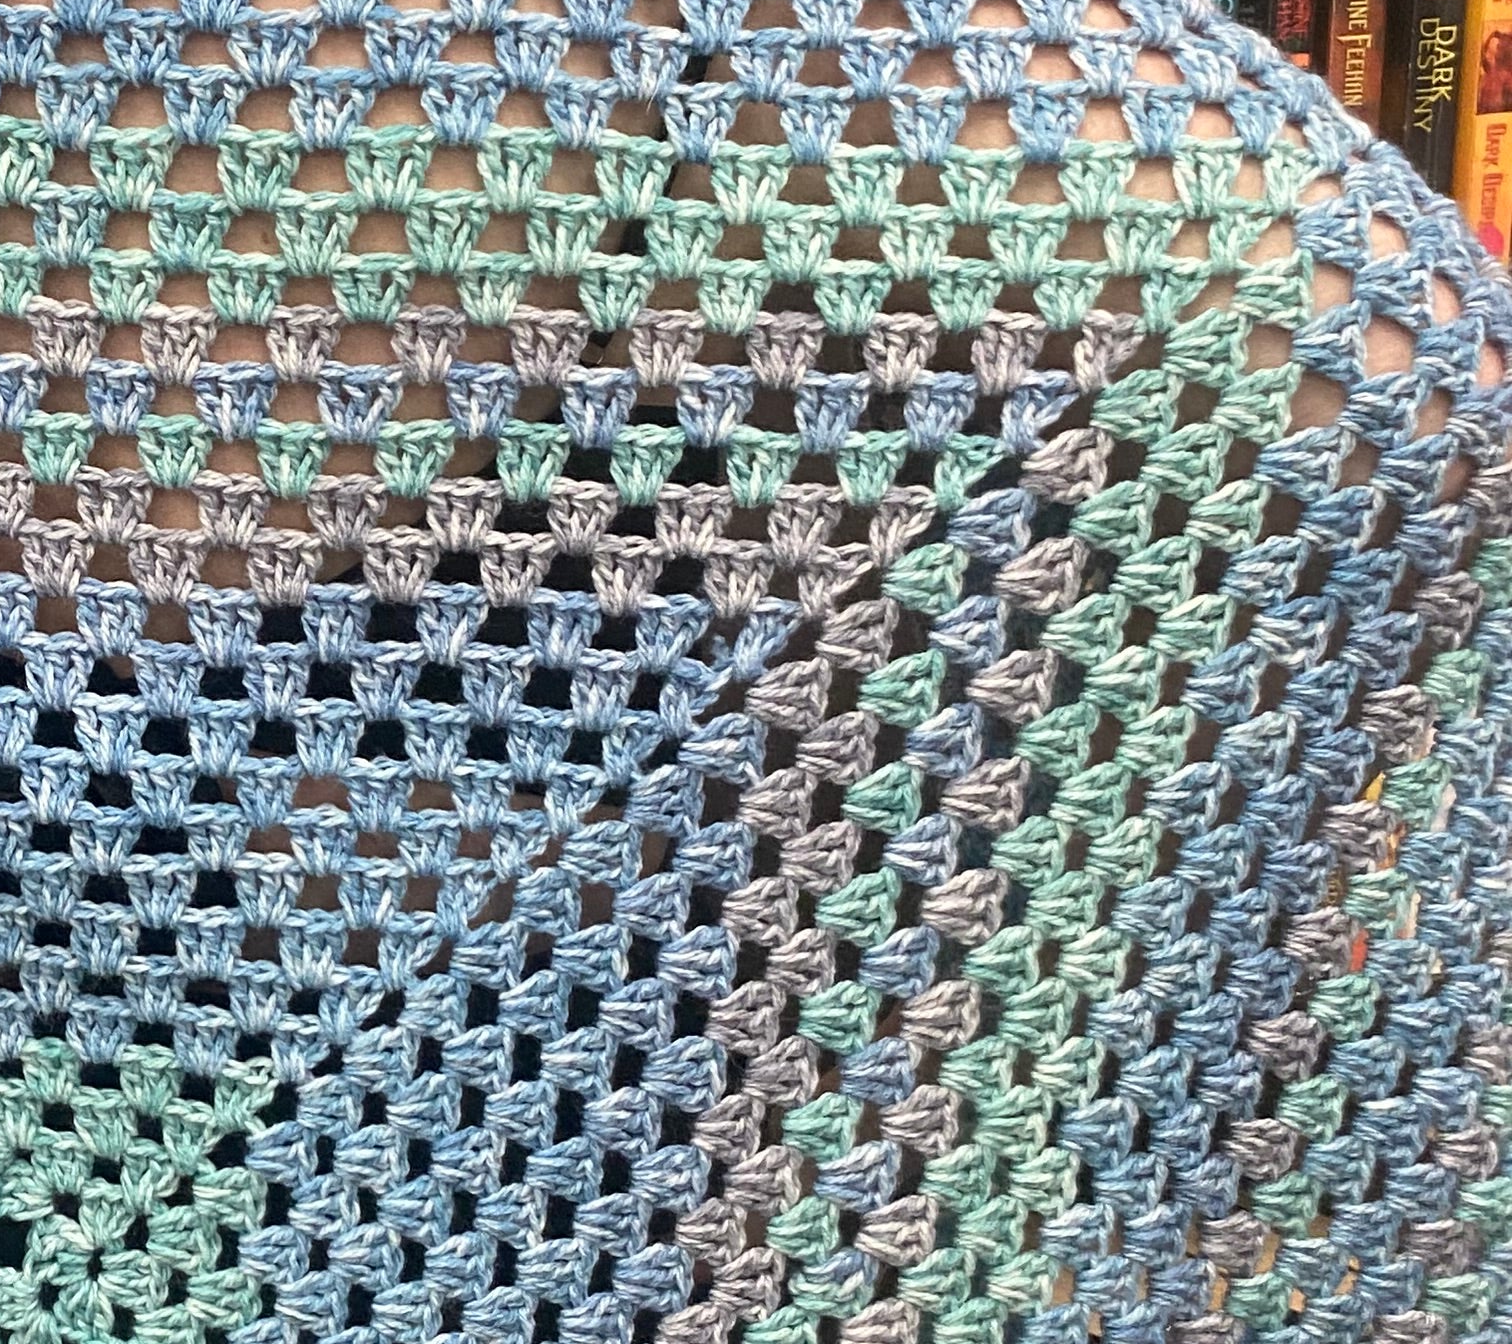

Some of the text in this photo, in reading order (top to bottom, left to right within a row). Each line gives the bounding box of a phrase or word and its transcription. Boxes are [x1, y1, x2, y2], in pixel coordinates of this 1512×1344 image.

[1336, 34, 1373, 107] FEEHAN
[1413, 17, 1440, 132] DESTINY
[1432, 24, 1458, 102] DARK
